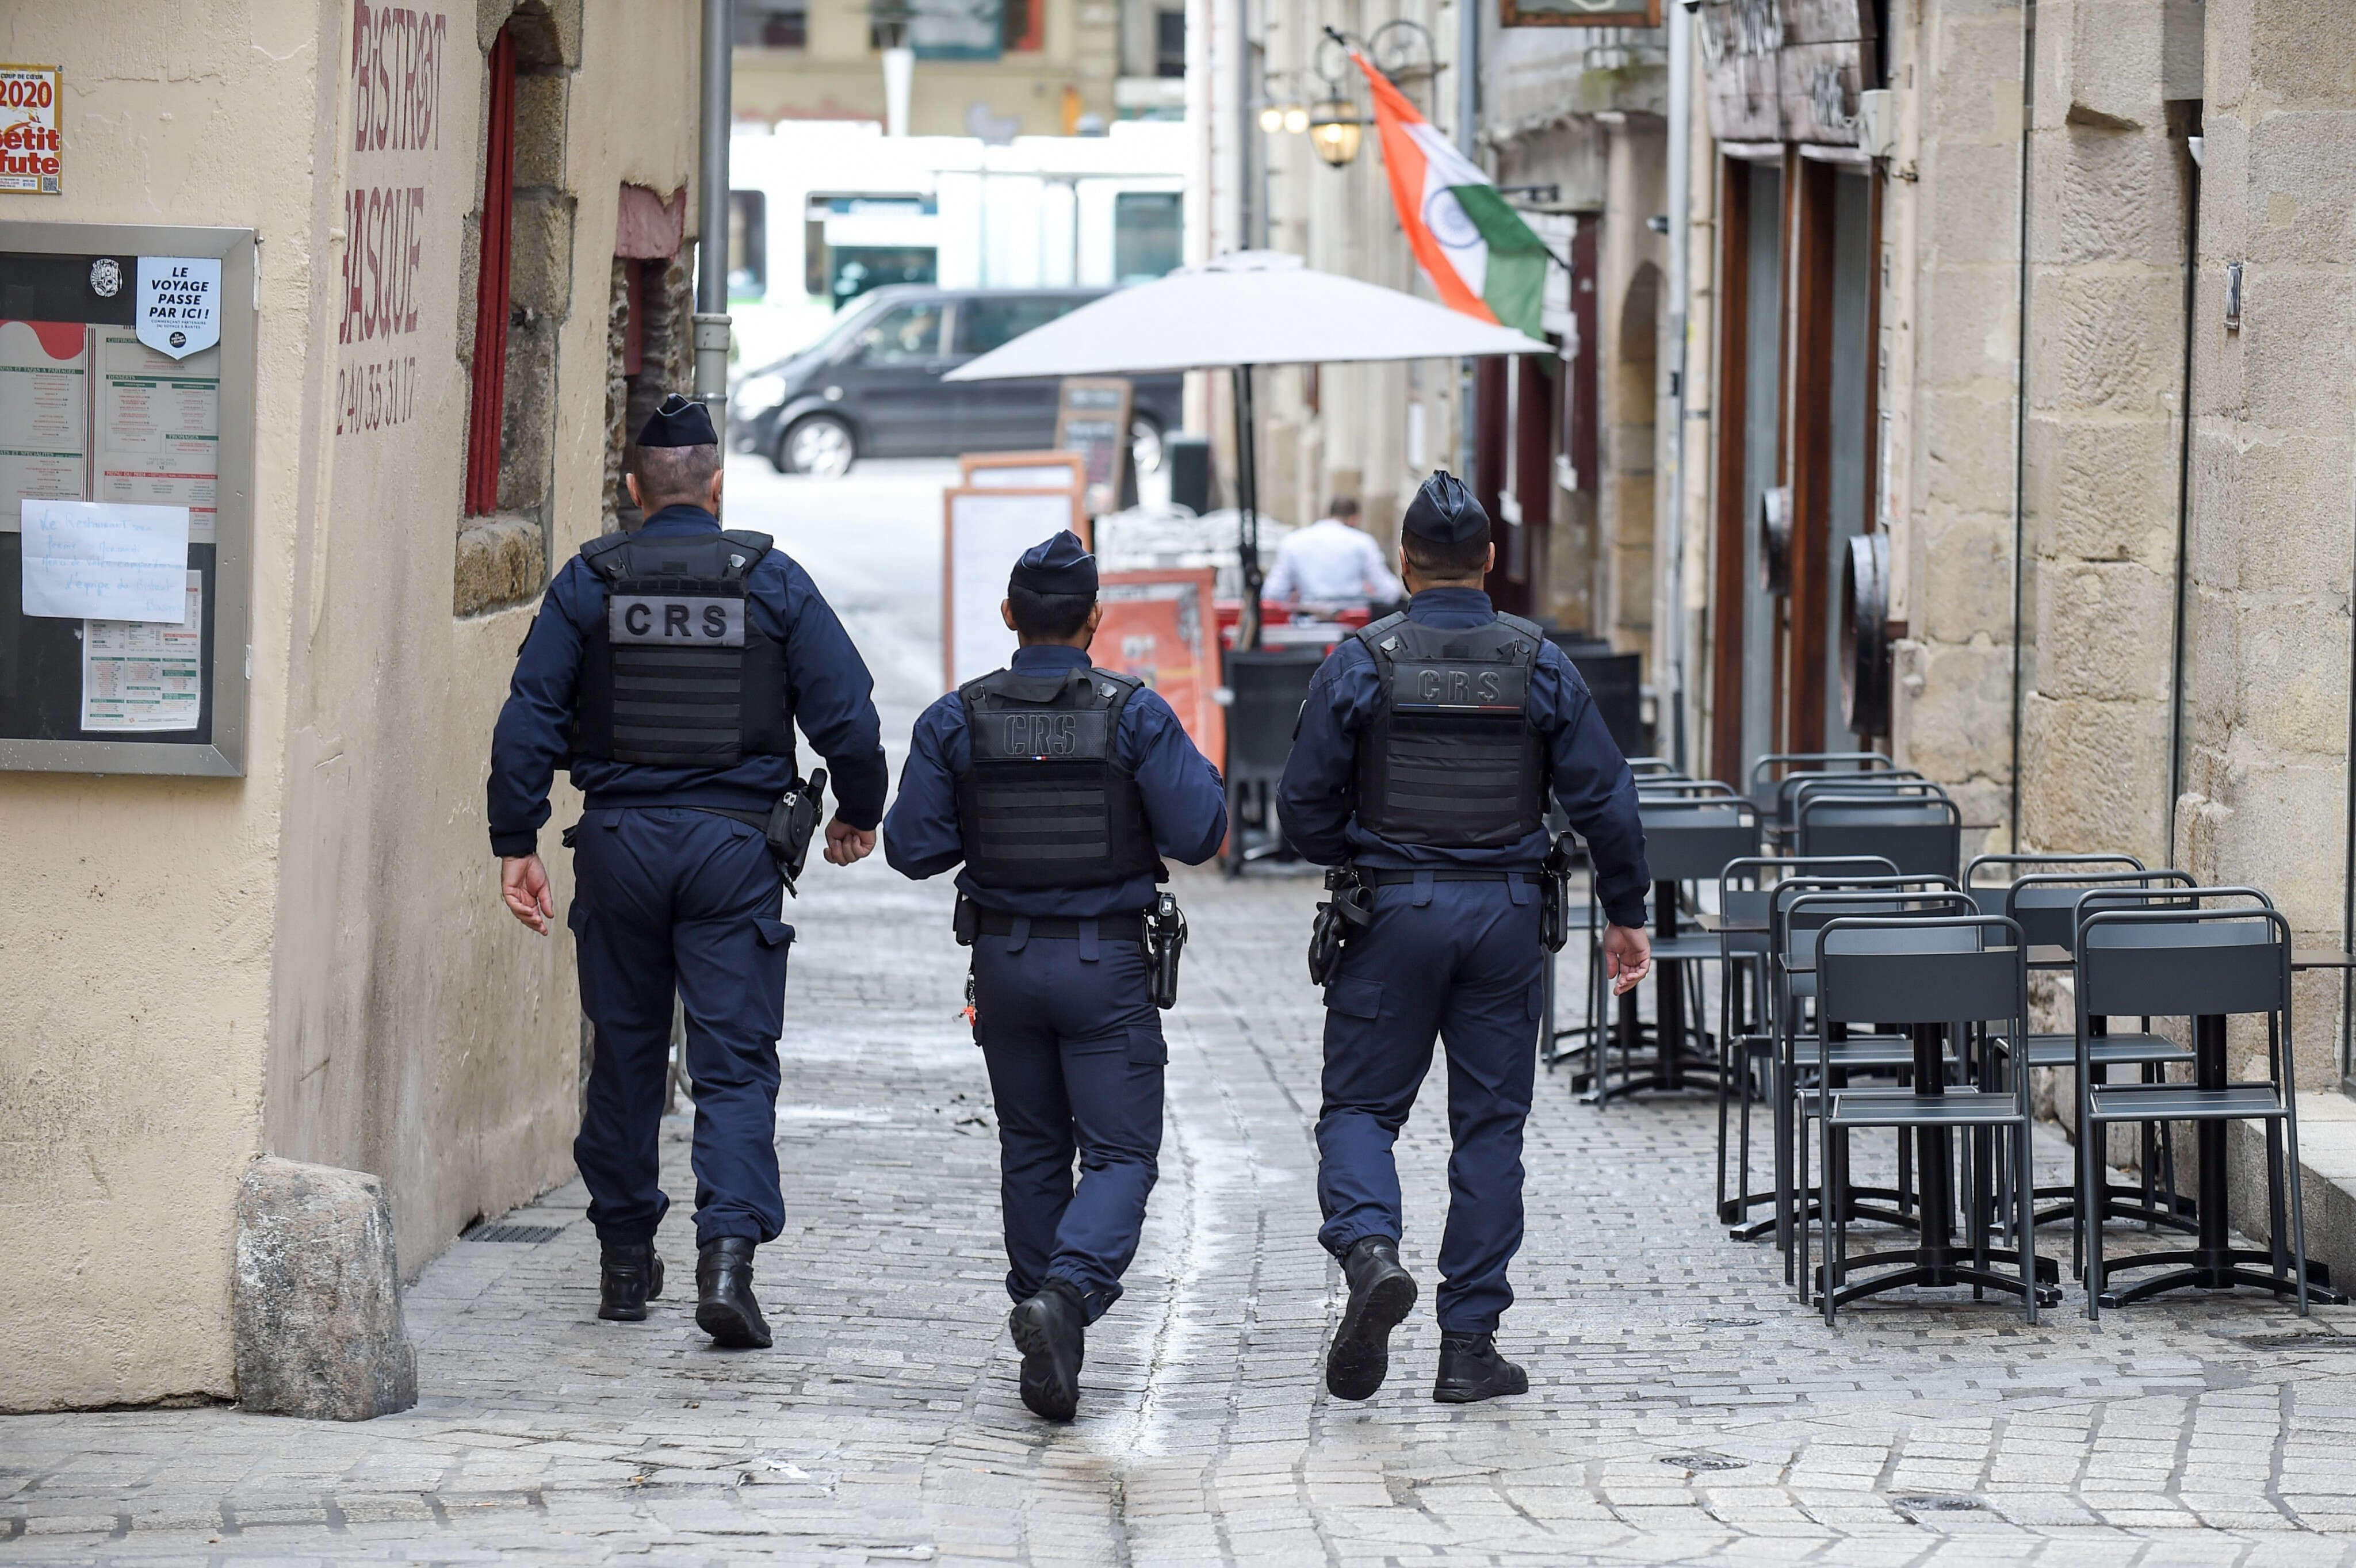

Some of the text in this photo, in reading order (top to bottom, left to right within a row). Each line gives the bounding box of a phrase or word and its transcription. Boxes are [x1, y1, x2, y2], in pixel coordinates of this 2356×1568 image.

[0, 81, 52, 108] 2020
[173, 267, 189, 277] LE
[152, 280, 209, 292] VOYAGE
[158, 294, 201, 305] PASSE
[149, 307, 177, 318] PAR
[366, 364, 382, 431] 35
[386, 358, 398, 426] 31
[403, 356, 415, 423] 17
[625, 603, 727, 638] CRS
[1418, 670, 1500, 702] CRS
[1004, 715, 1076, 755] CRS
